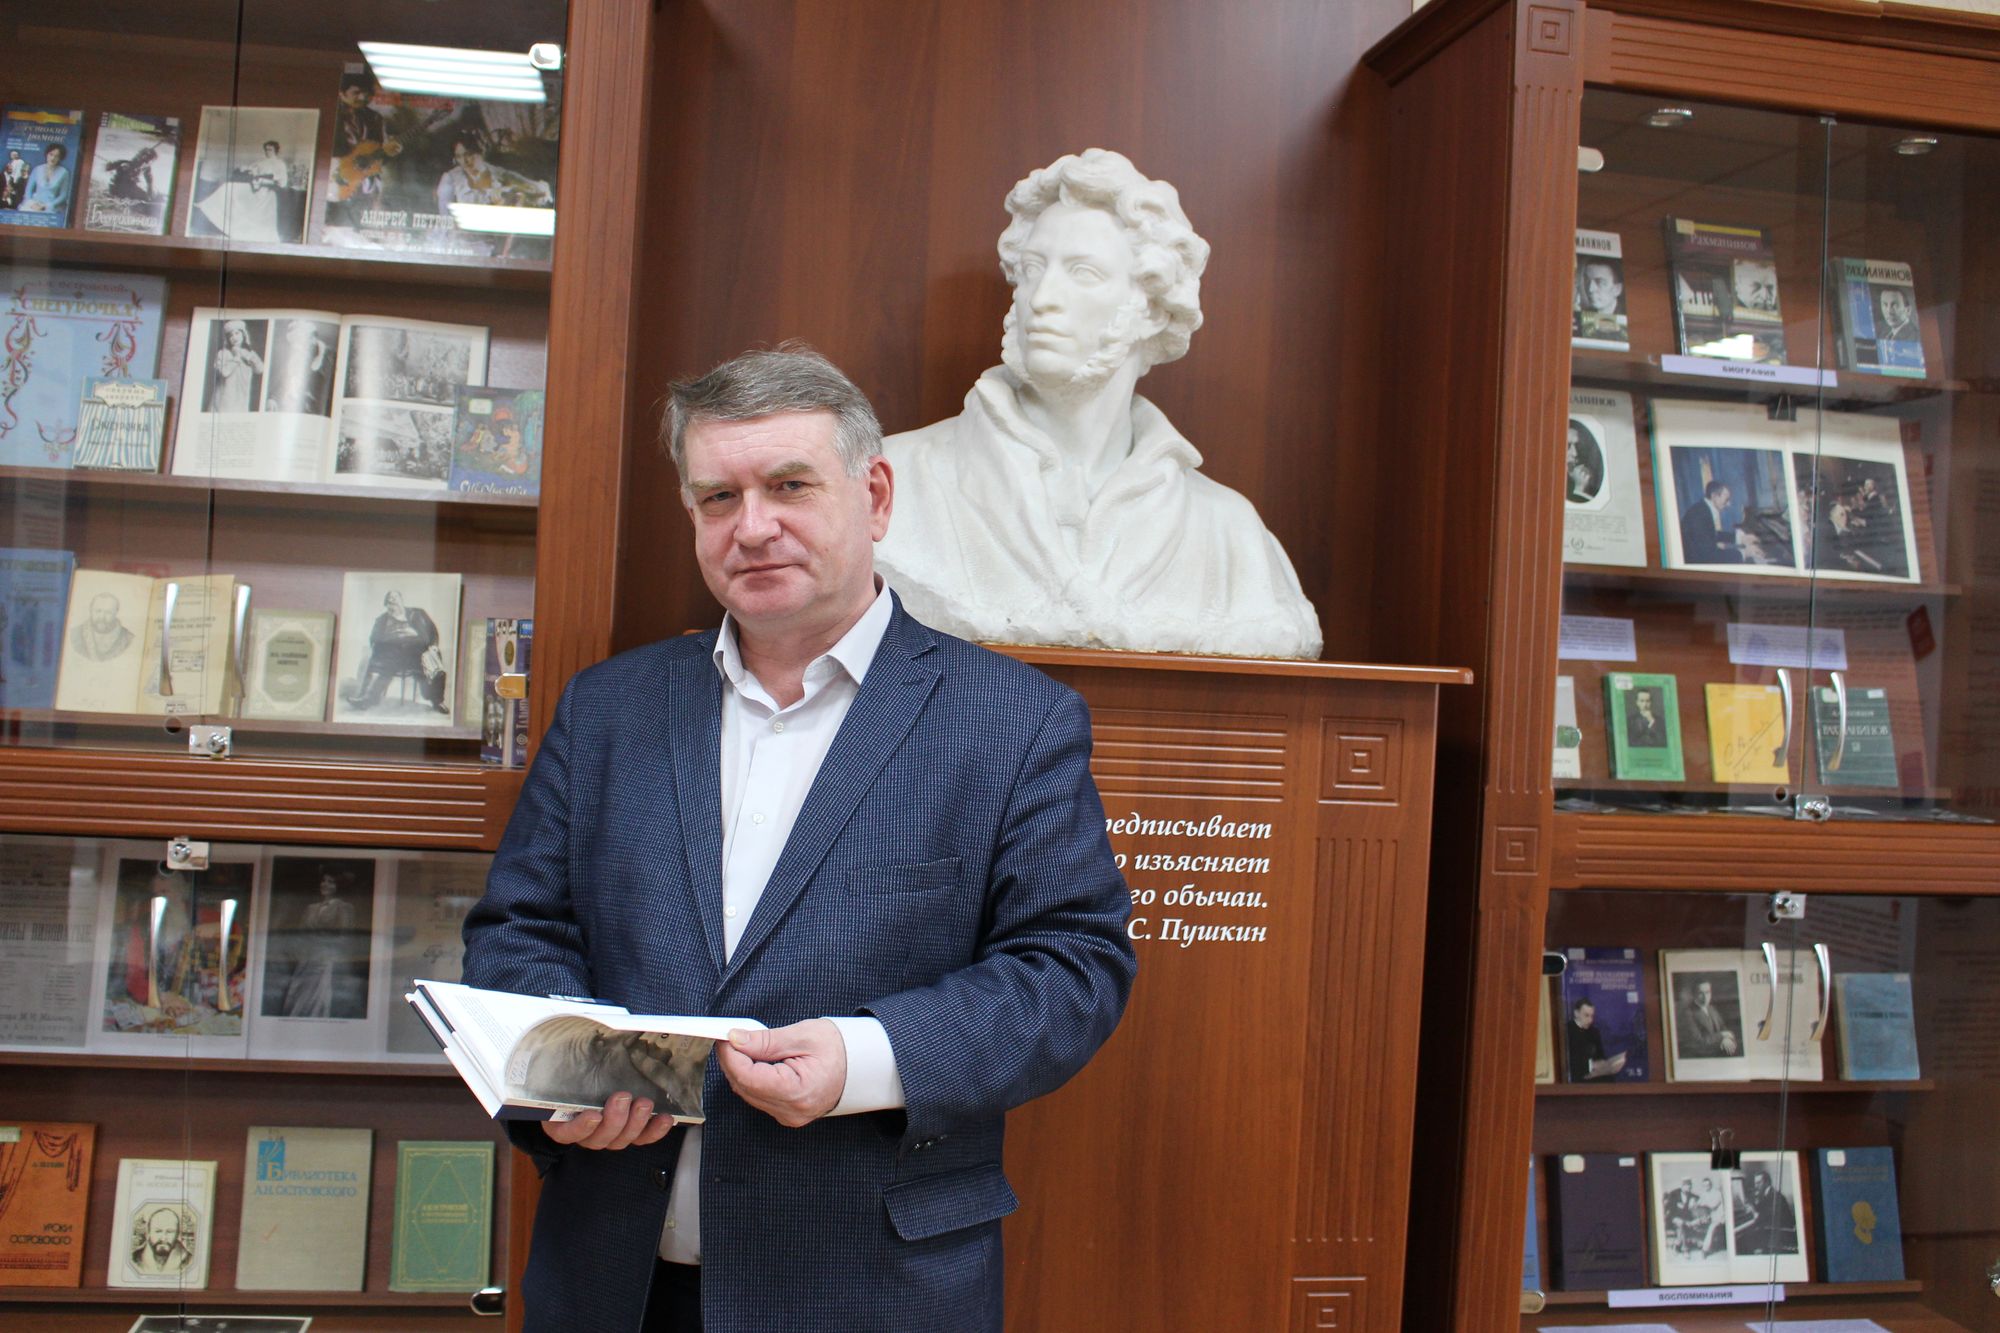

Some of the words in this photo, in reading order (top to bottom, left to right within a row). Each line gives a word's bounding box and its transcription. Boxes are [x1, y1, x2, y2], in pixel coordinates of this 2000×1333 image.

[360, 209, 407, 227] АНДРЕЙ
[1690, 234, 1757, 251] Рахманинов
[1846, 264, 1911, 280] РАХМАНИНОВ
[1722, 365, 1776, 377] БИОГРАФИЯ
[1134, 854, 1270, 874] изъясняет
[1163, 883, 1268, 909] обычаи.
[1158, 918, 1267, 949] Пушкин
[275, 1186, 358, 1198] ОСТРОВСКОГО
[43, 1222, 73, 1234] УРОКИ
[10, 1234, 72, 1246] ОСТРОВСКОГО
[1658, 1291, 1734, 1302] ВОСПОМИНАНИЯ
